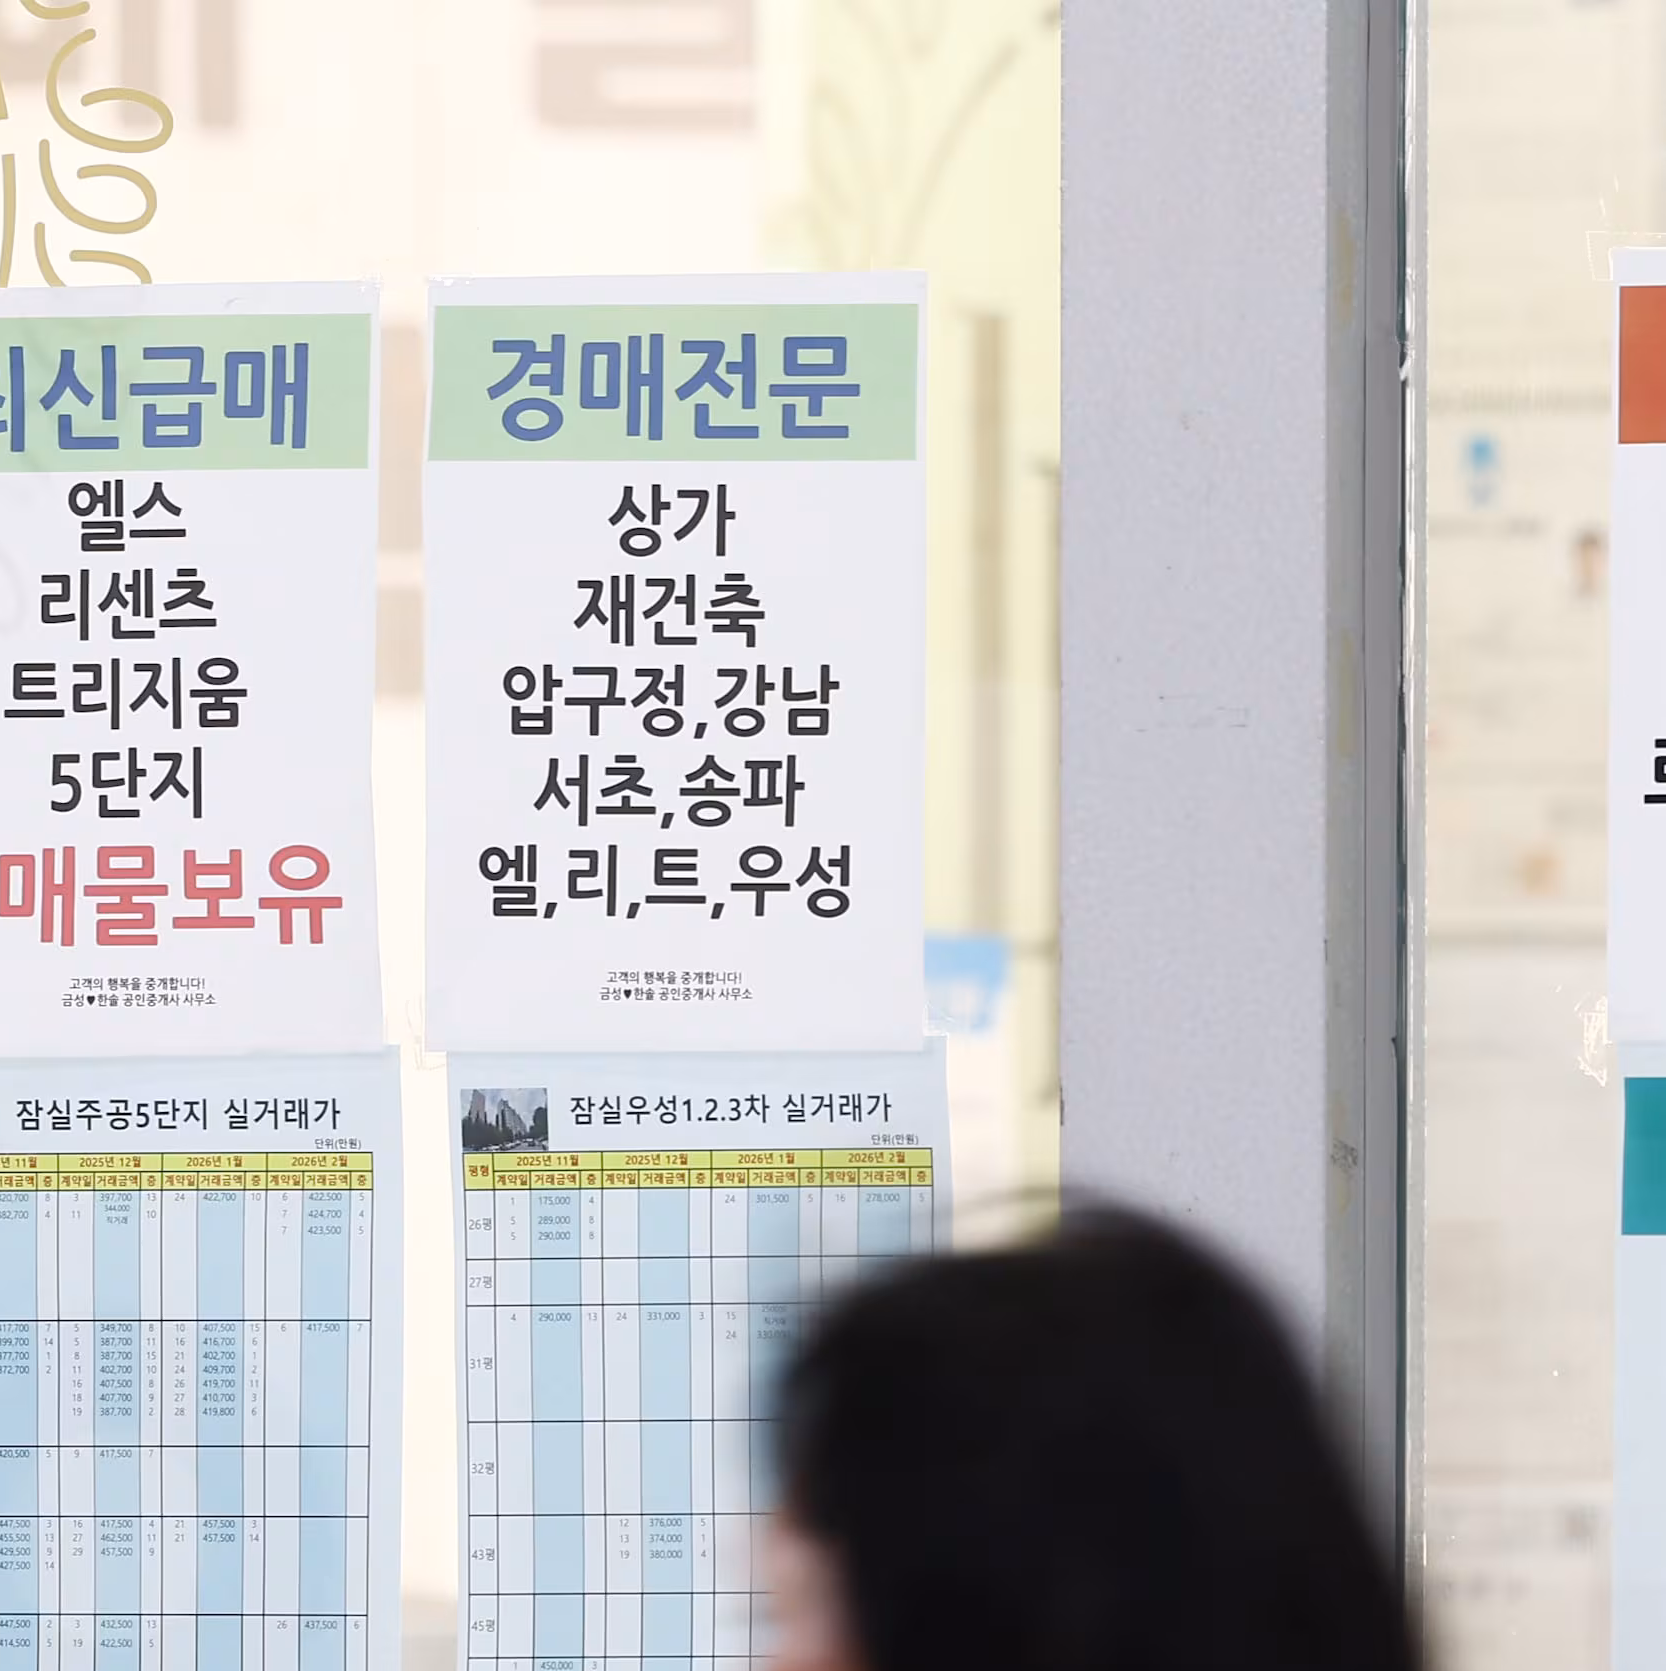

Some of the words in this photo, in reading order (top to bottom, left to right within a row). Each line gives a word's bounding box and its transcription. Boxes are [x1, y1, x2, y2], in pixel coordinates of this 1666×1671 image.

[487, 334, 860, 441] 경매전문
[69, 480, 186, 551] 엘스
[608, 484, 735, 557] 상가
[41, 569, 216, 640] 리센츠
[574, 574, 765, 647] 재건축
[4, 658, 247, 729] 트리지움
[503, 665, 839, 739] 압구정,강남
[51, 747, 202, 818] 5단지
[534, 755, 805, 829] 서초,송파
[479, 845, 850, 919] 엘,리,트,우성
[17, 1099, 206, 1130] 잠실주공5단지
[224, 1098, 340, 1130] 실거래가
[314, 1137, 362, 1151] 단위(만원)
[571, 1094, 770, 1125] 잠실우성1.2.3차
[783, 1093, 891, 1122] 실거래가
[870, 1133, 920, 1147] 단위(만원)
[79, 1156, 115, 1168] 2025년
[187, 1156, 222, 1168] 2026년
[291, 1155, 327, 1168] 2026년
